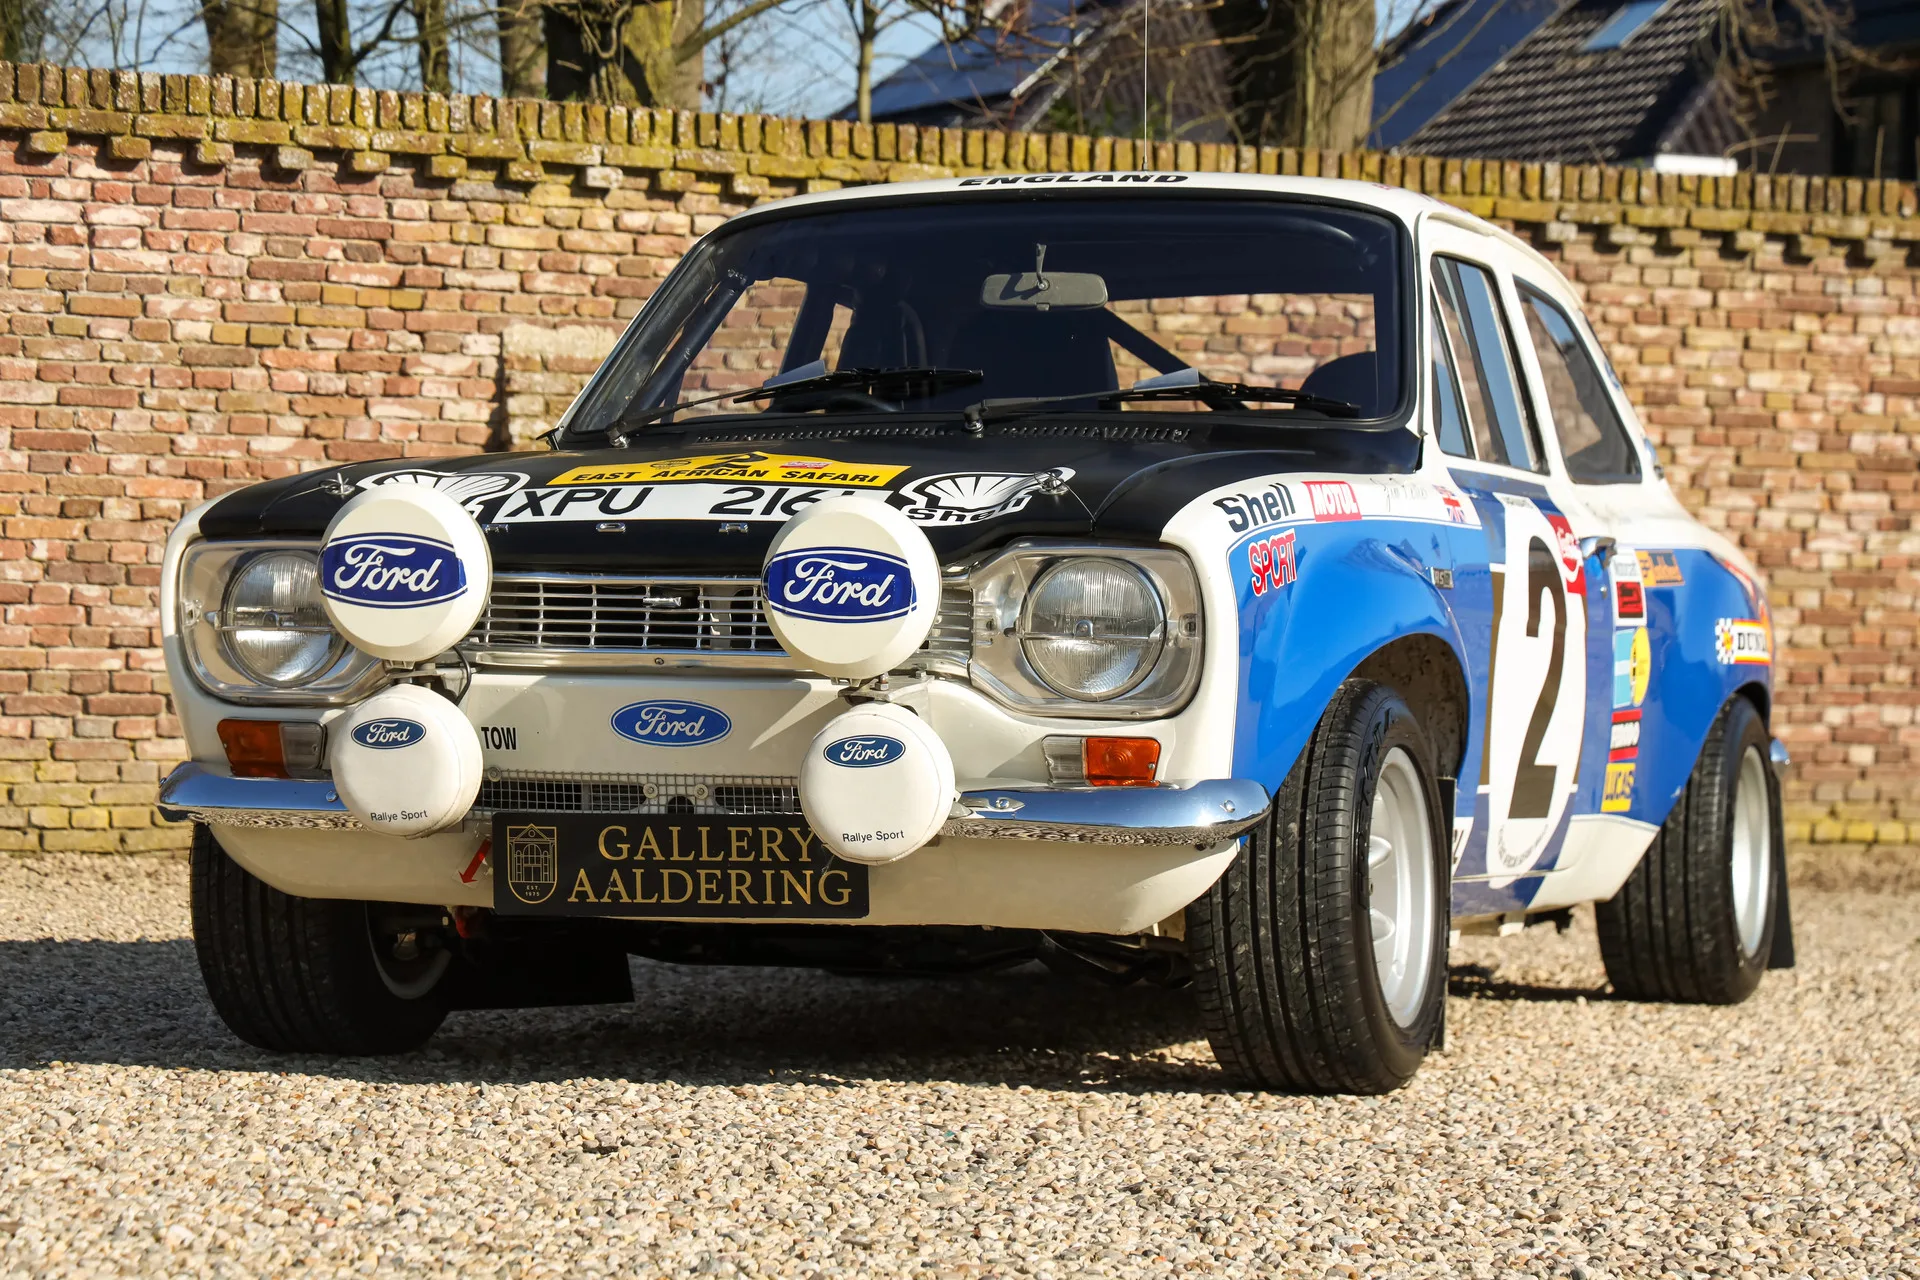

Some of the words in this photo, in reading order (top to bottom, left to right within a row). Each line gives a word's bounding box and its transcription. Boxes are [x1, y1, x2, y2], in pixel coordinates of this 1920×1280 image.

[958, 174, 1189, 187] ENGLAND
[571, 471, 641, 482] EAST
[651, 467, 767, 479] AFRICAN
[781, 470, 881, 483] SAFARI
[503, 486, 655, 518] XPU
[708, 486, 855, 517] 216
[1213, 482, 1296, 533] Shell
[1309, 484, 1360, 515] MOTUL
[334, 543, 443, 593] Ford
[1248, 528, 1298, 597] SPORT
[783, 557, 896, 607] Ford
[1507, 535, 1568, 820] 2
[365, 721, 411, 744] Ford
[634, 705, 706, 738] Ford
[480, 726, 517, 751] TOW
[839, 737, 889, 761] Ford
[370, 811, 398, 823] Rallye
[400, 809, 428, 821] Sport
[597, 825, 815, 863] GALLERY
[842, 832, 873, 844] Rallye
[875, 829, 905, 842] Sport
[567, 867, 853, 906] AALDERING
